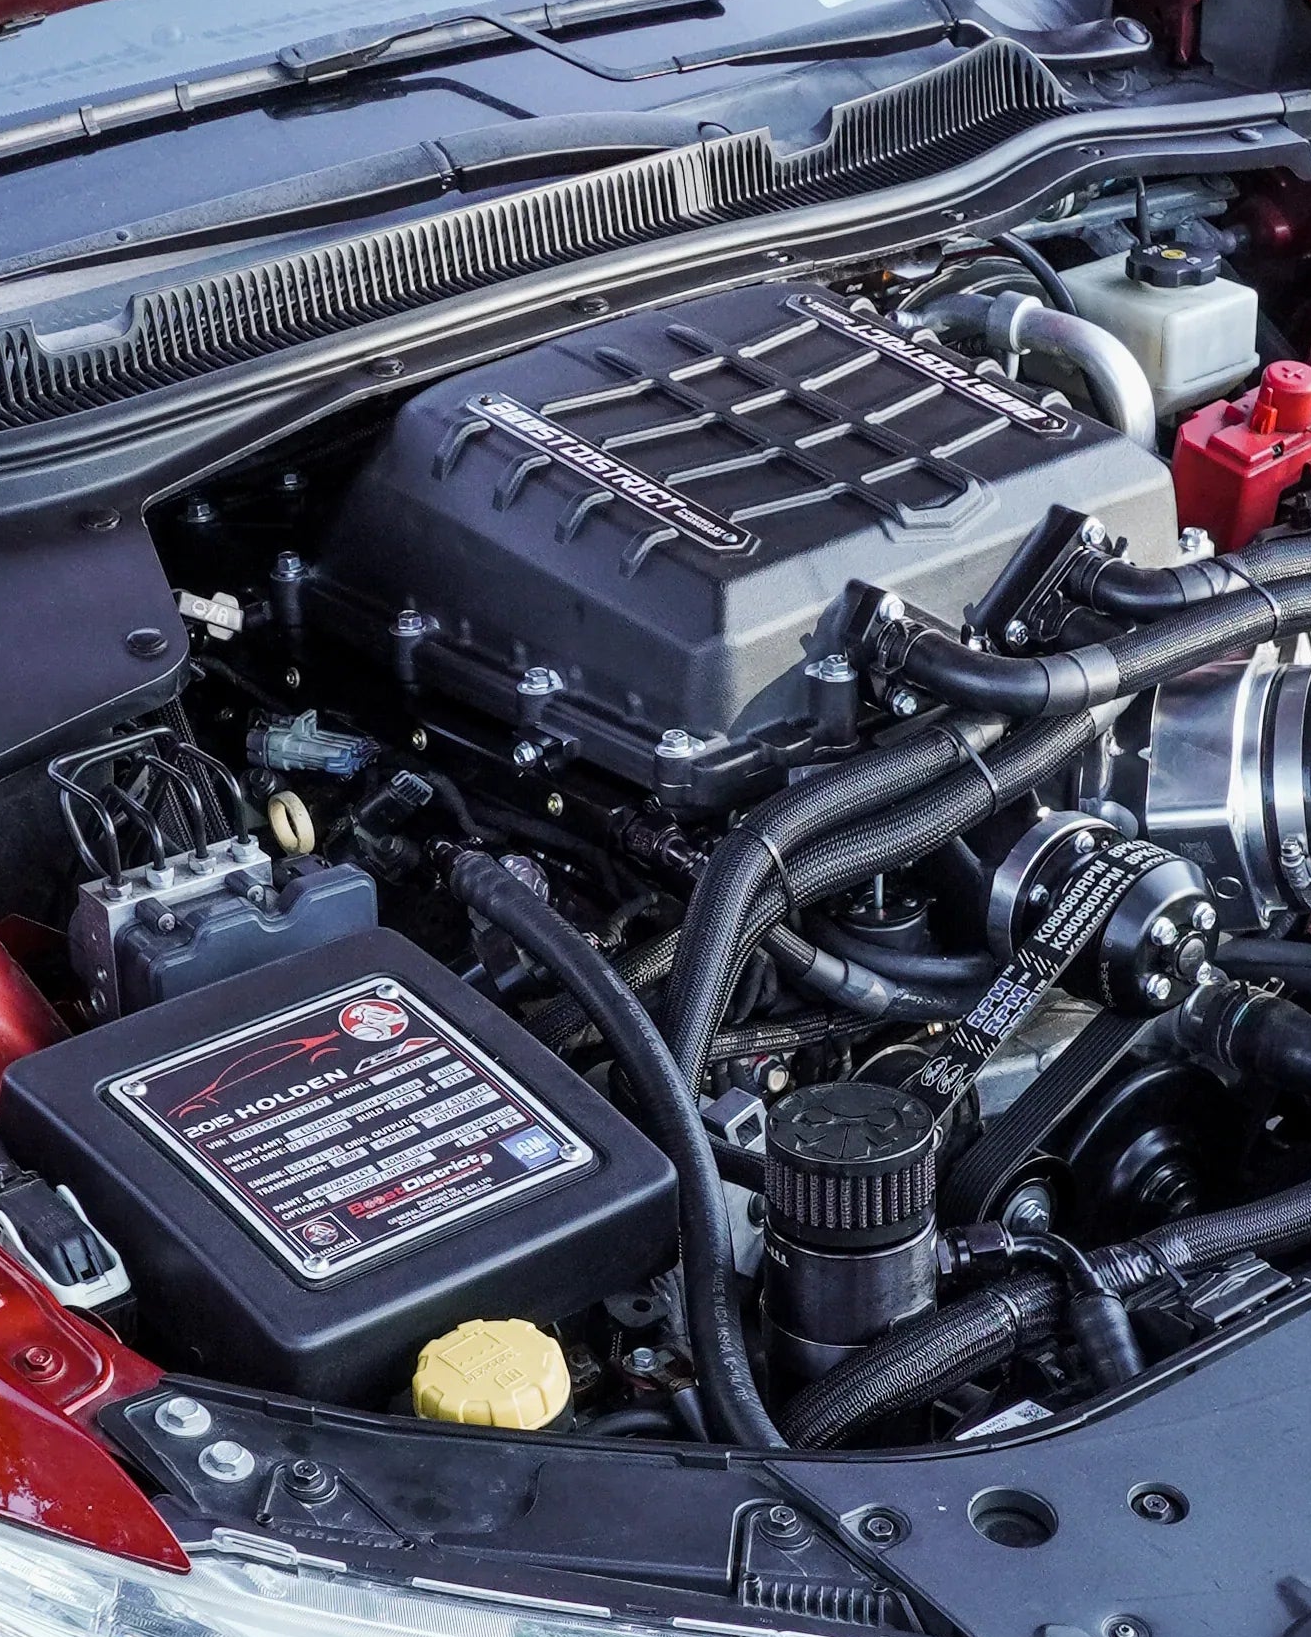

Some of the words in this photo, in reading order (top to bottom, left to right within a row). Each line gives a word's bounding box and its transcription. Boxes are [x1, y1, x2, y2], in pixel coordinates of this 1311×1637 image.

[1034, 860, 1110, 943] K080680RPM
[1050, 868, 1125, 951] K080680RPM
[183, 1113, 234, 1139] 2015
[235, 1069, 347, 1119] HOLDEN
[205, 1138, 229, 1150] VIN:
[333, 1081, 372, 1100] MODEL:
[222, 1150, 253, 1166] BUILD
[251, 1137, 286, 1154] PLANT:
[346, 1100, 376, 1117] SOUTH
[376, 1081, 421, 1104] AUSTRALIA
[230, 1157, 261, 1173] BUILD
[259, 1147, 289, 1162] DATE:
[325, 1122, 349, 1135] 2015
[355, 1107, 385, 1123] BUILD
[425, 1083, 439, 1094] OF
[516, 1135, 545, 1156] GM
[247, 1170, 288, 1189] ENGINE:
[344, 1135, 373, 1150] ORIG.
[371, 1118, 413, 1139] OUTPUT:
[255, 1160, 330, 1196] TRANSMISSION:
[434, 1096, 486, 1123] AUTOMATIC
[272, 1196, 305, 1213] PAINT:
[383, 1152, 409, 1168] SOME
[472, 1108, 513, 1127] METALLIC
[281, 1199, 328, 1221] OPTIONS:
